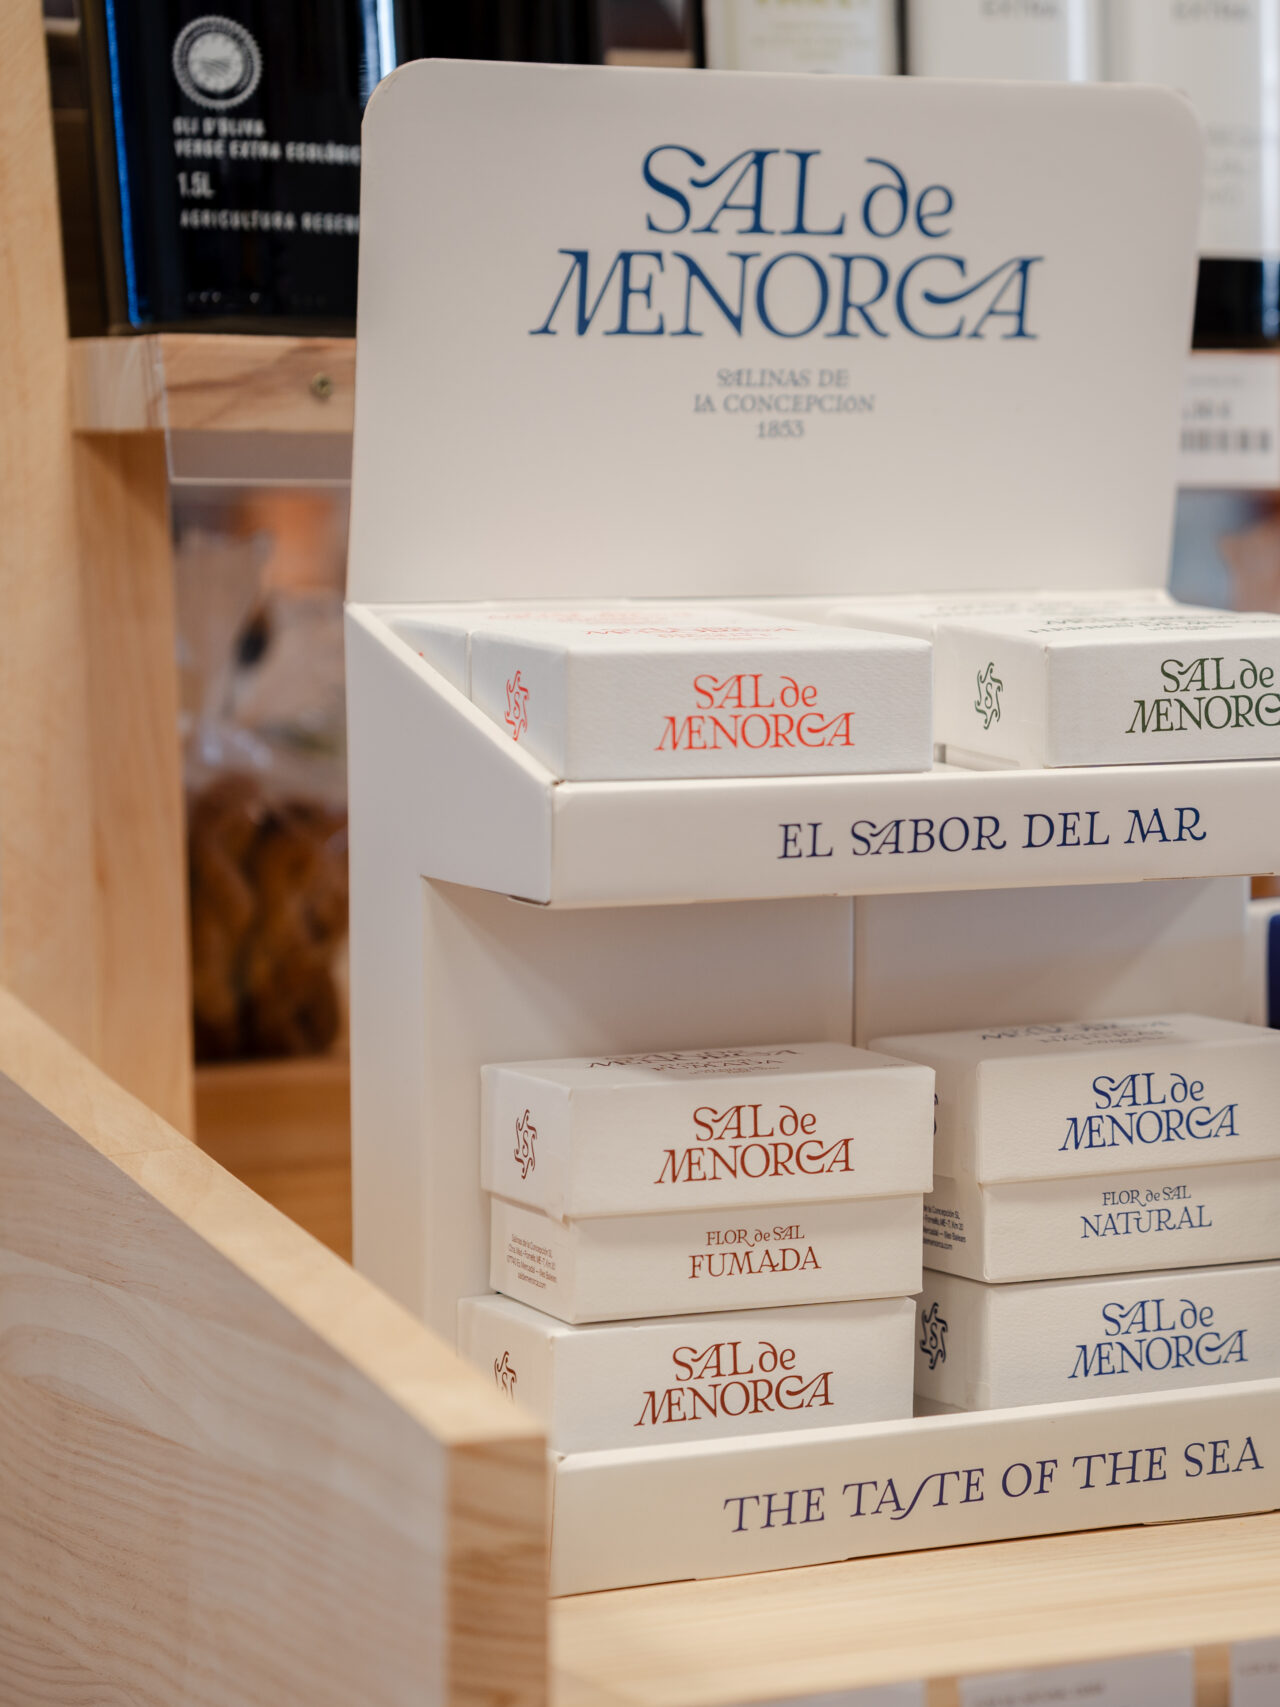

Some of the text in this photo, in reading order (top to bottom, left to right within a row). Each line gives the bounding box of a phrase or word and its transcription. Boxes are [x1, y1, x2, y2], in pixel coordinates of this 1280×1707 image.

[643, 145, 954, 238] SAL de
[180, 209, 296, 231] AGRICULTURA
[530, 249, 1042, 339] MENORCA
[716, 368, 849, 388] SALINAS DE
[757, 420, 804, 438] 1853
[694, 674, 817, 709] SAL de
[1161, 657, 1273, 693] SAL de
[656, 712, 854, 750] MENORCA
[778, 823, 833, 859] EL
[851, 816, 1006, 855] SABOR
[1022, 811, 1109, 848] DEL
[1093, 1073, 1204, 1109] SAL de
[693, 1104, 816, 1141] SAL de
[1059, 1103, 1239, 1151] MENORCA
[654, 1137, 854, 1184] MENORCA
[1102, 1185, 1191, 1207] FLOR de SAL
[706, 1225, 804, 1247] FLOR de SAL
[1080, 1205, 1212, 1238] NATURAL
[689, 1246, 821, 1279] FUMADA
[1102, 1299, 1213, 1336] SAL de
[672, 1341, 795, 1382] SAL de
[1068, 1328, 1248, 1378] MENORCA
[634, 1371, 834, 1426] MENORCA
[724, 1437, 1264, 1532] THE TASTE OF THE SEA
